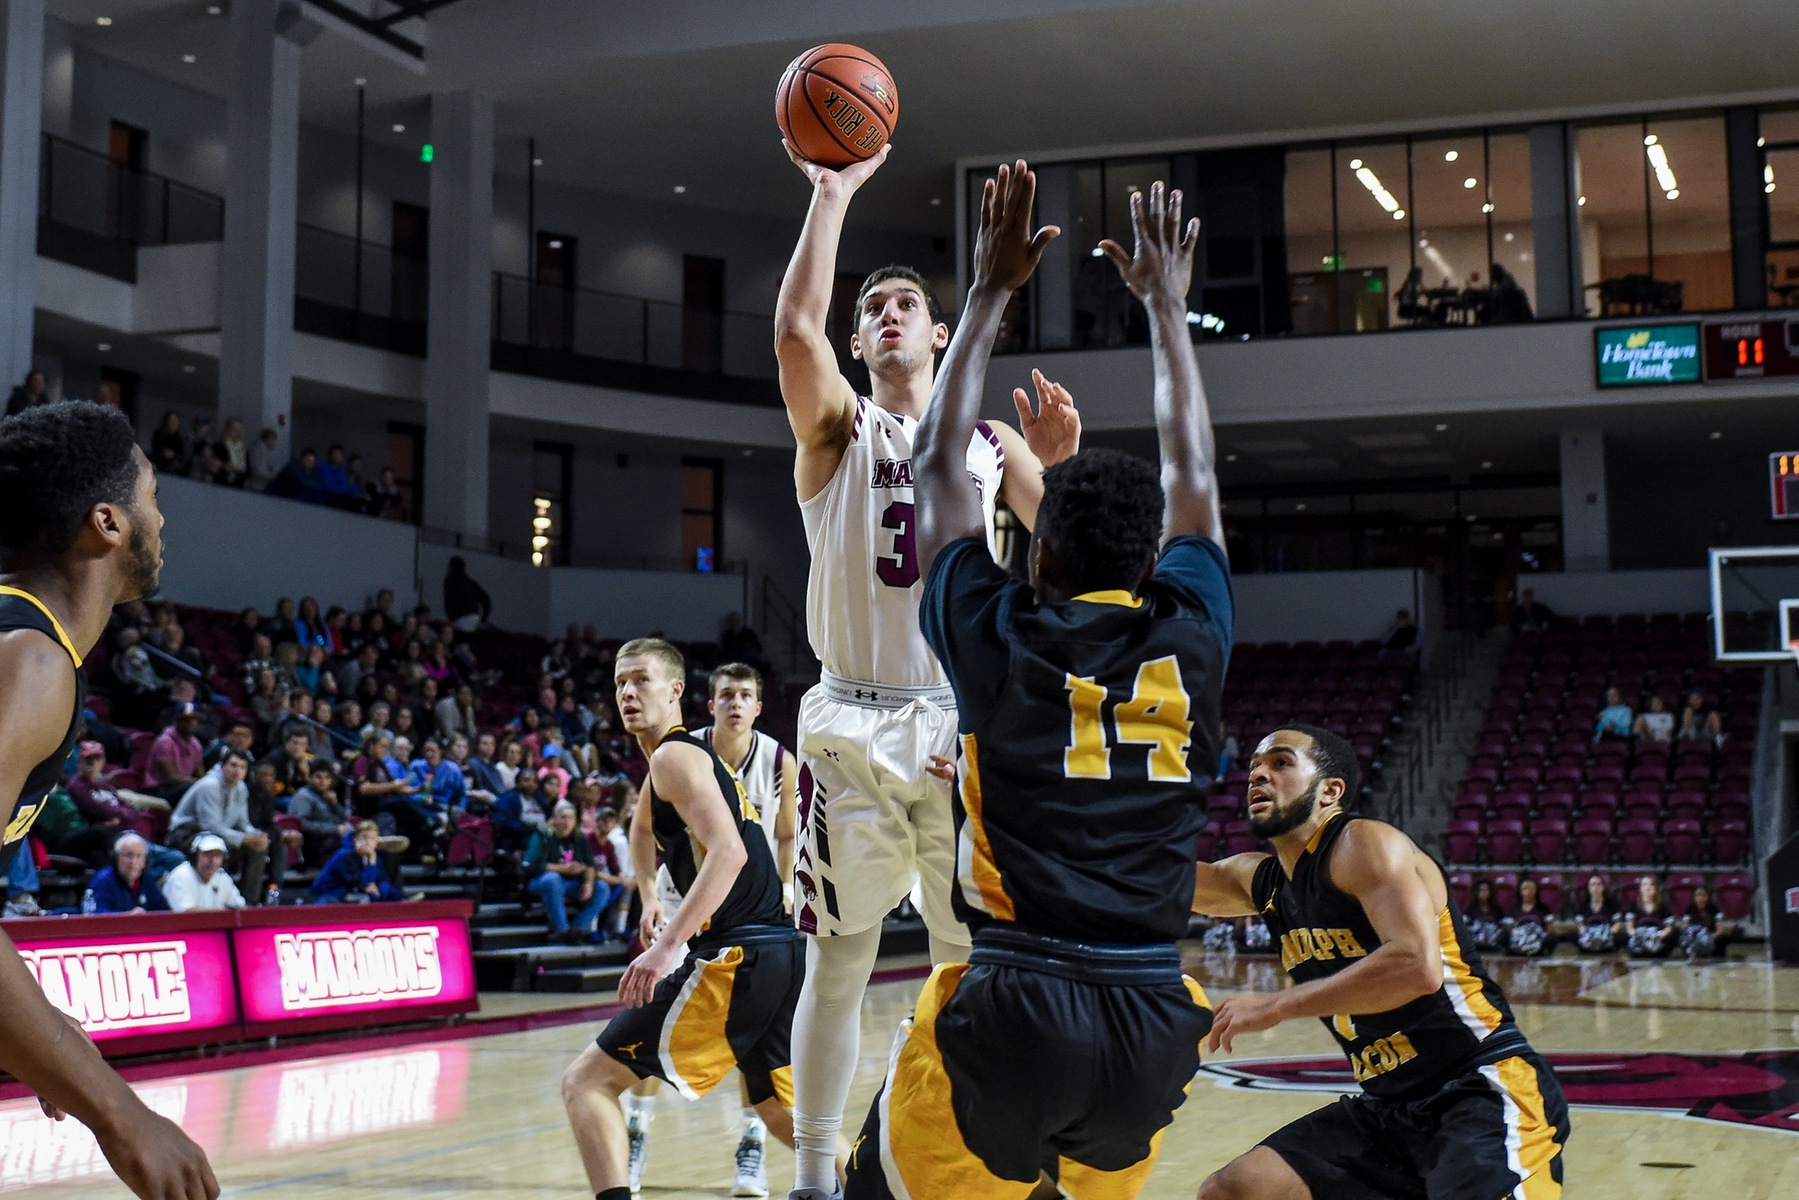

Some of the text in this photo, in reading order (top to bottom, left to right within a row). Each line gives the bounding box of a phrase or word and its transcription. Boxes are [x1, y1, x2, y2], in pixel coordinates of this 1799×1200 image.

[823, 90, 867, 138] ROCK
[1626, 359, 1674, 382] Bank
[1737, 338, 1765, 365] 11
[1063, 654, 1195, 783] 14
[20, 945, 188, 1028] ANOKE
[277, 929, 441, 1006] MAROONS
[1350, 1030, 1419, 1083] ACON
